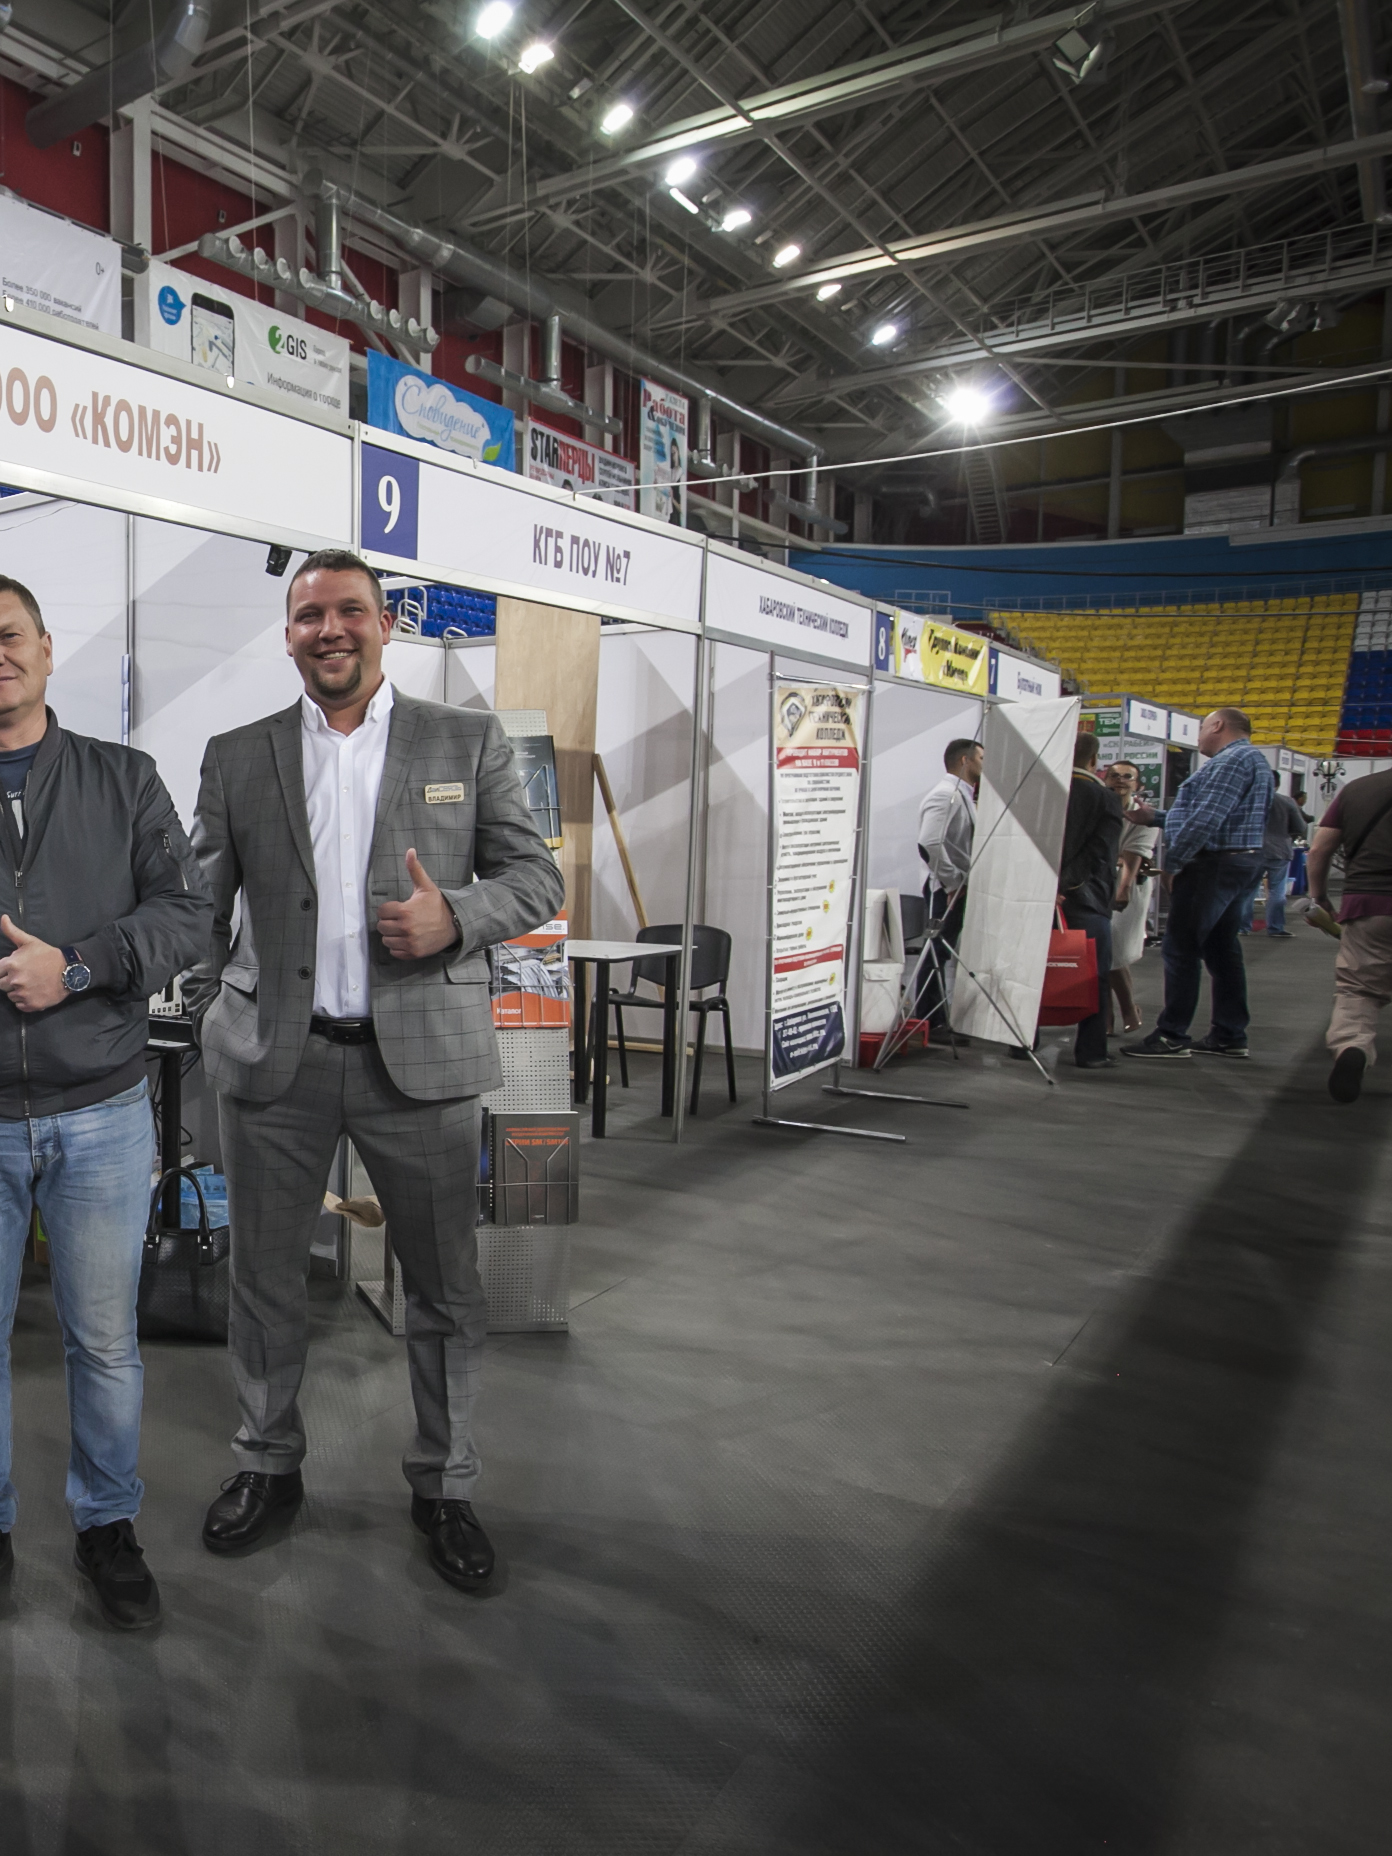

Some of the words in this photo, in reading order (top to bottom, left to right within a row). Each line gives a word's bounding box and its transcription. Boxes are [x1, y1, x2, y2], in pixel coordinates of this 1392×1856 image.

[267, 371, 312, 399] Информация
[642, 389, 686, 426] Работа
[70, 390, 221, 475] «КОМЭН»
[401, 384, 481, 442] Сновидение
[377, 475, 401, 534] 9
[533, 523, 563, 569] КГБ
[570, 534, 601, 579] ПОУ
[605, 545, 630, 586] №7
[877, 626, 887, 661] 8
[428, 793, 462, 803] ВЛАДИМИР
